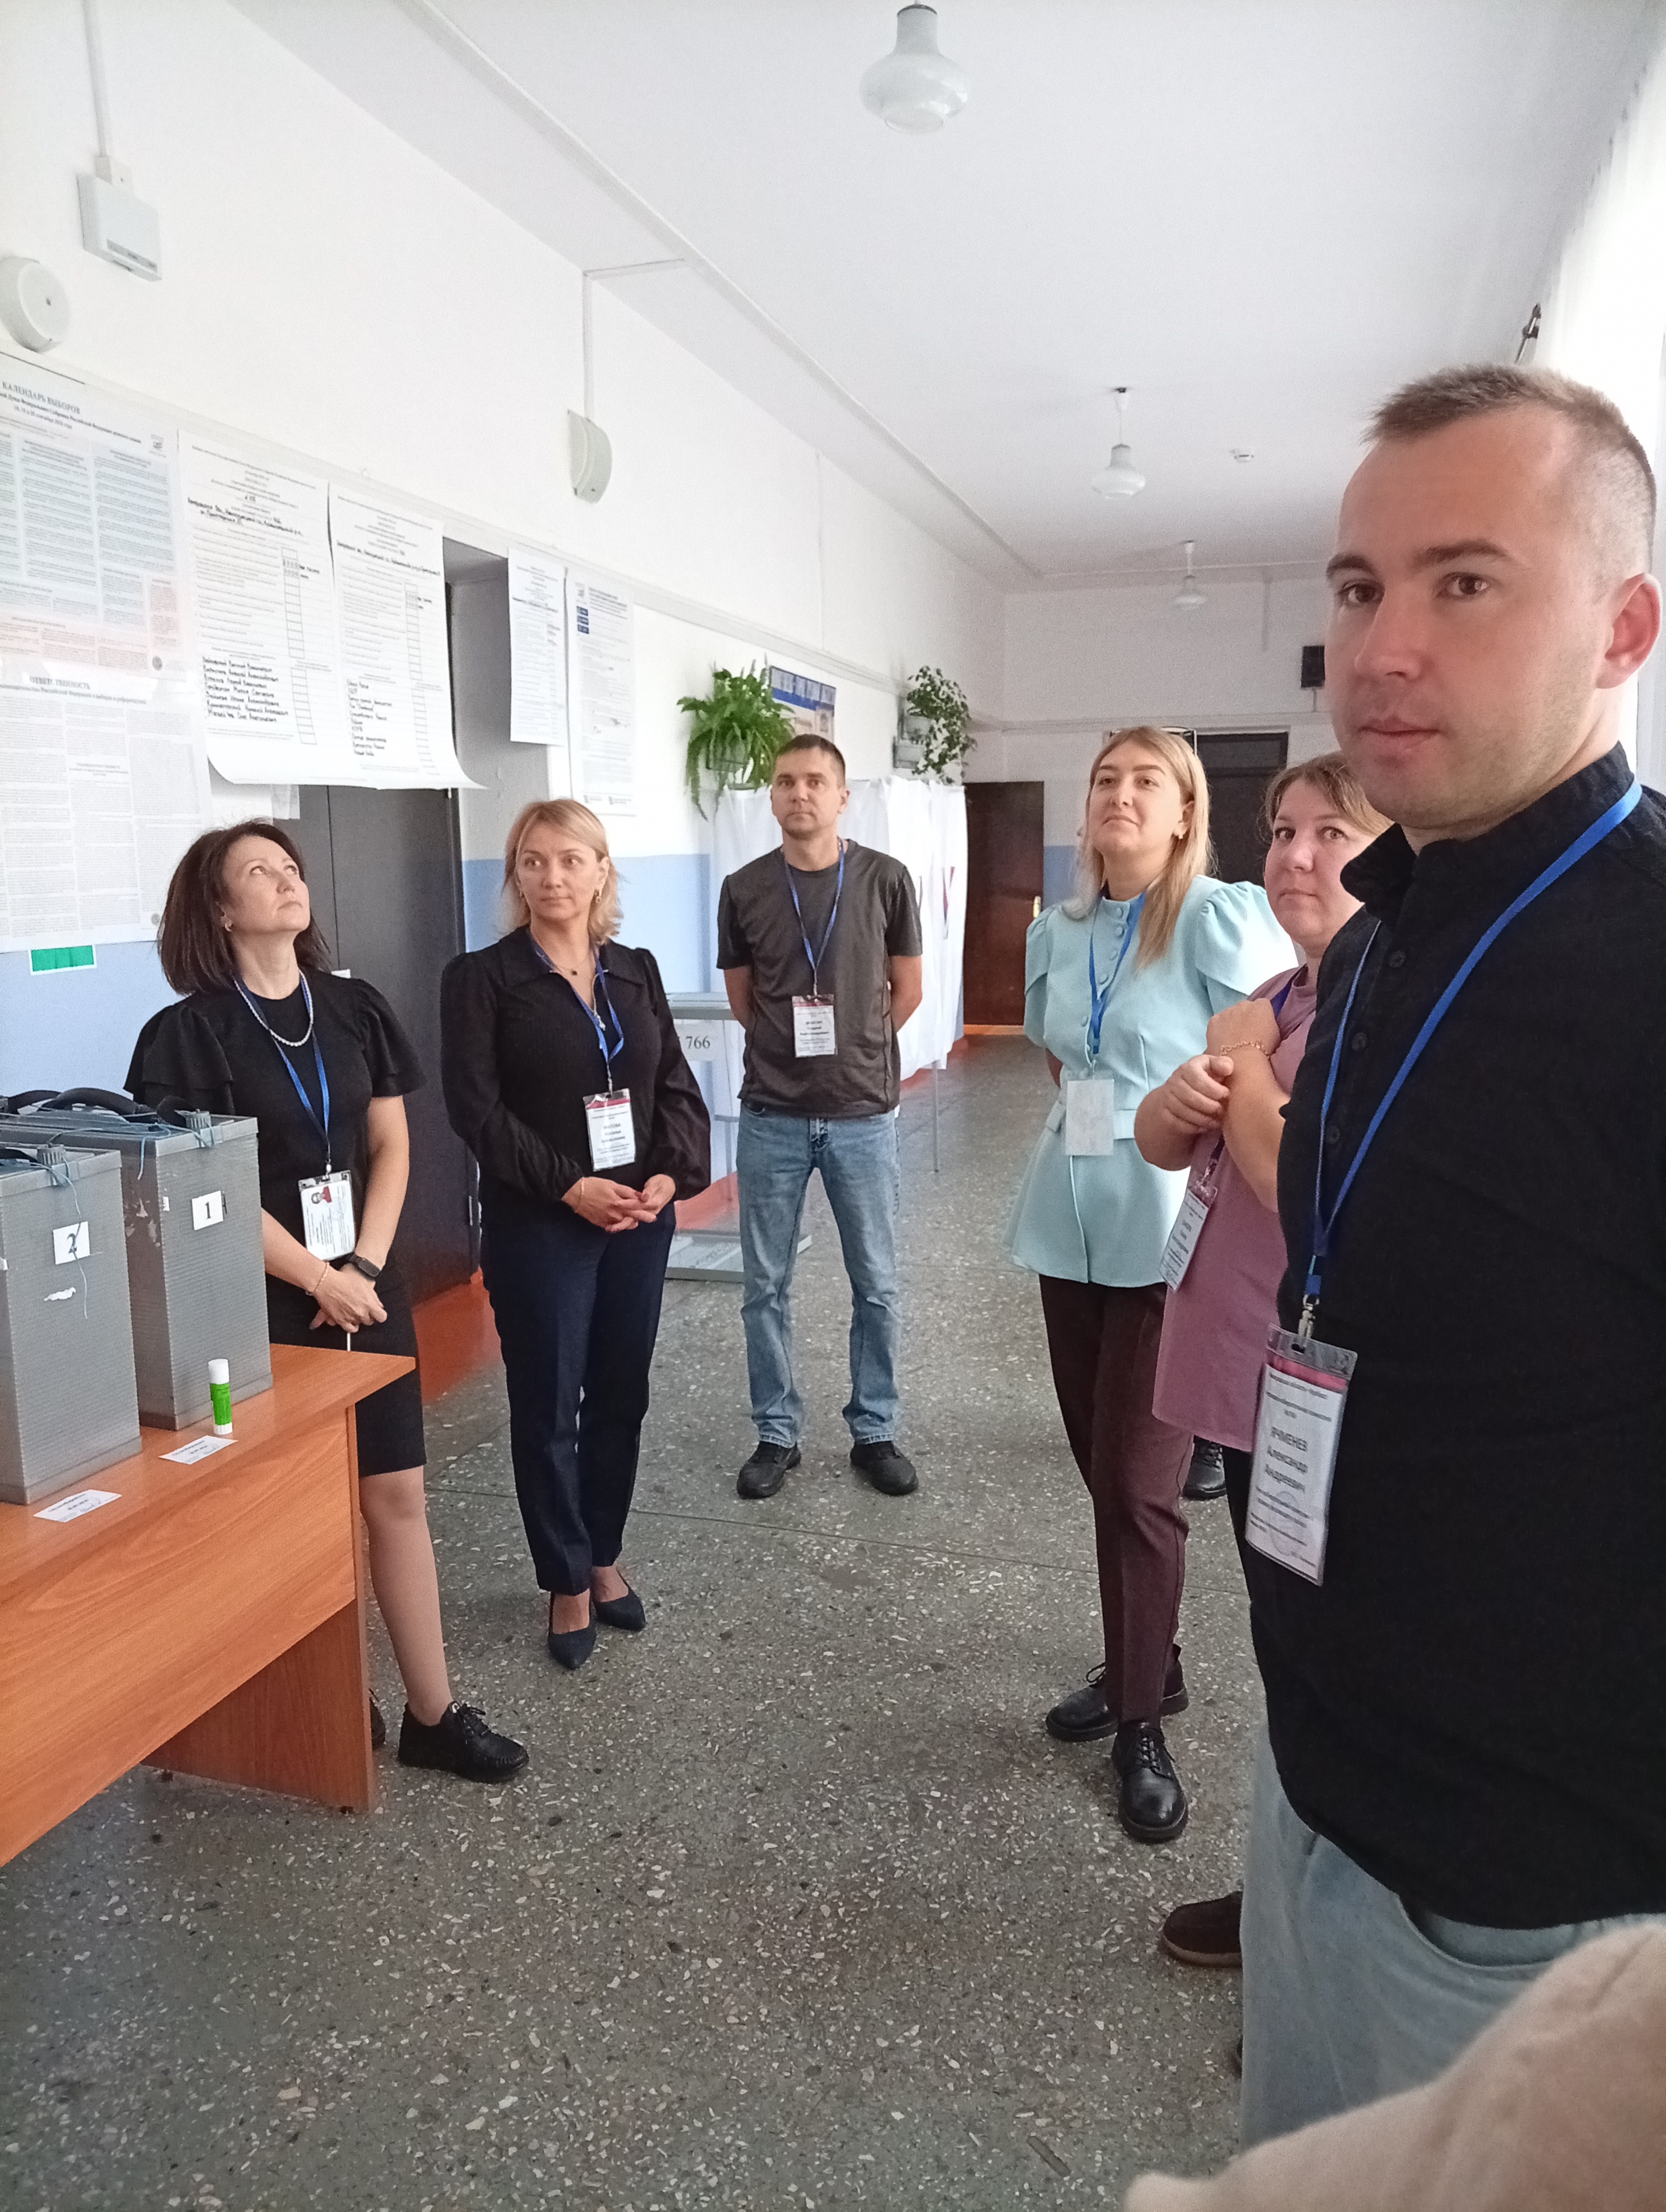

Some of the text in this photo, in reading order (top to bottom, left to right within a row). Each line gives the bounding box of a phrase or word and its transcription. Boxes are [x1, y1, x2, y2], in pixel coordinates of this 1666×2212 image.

[2, 381, 80, 414] КАЛЕНДАРЬ ВЫБОРОВ
[29, 676, 91, 690] ОТВЕТТВЕННОСТЬ
[685, 1035, 710, 1049] 766
[204, 1201, 211, 1219] 1
[67, 1233, 77, 1254] 2
